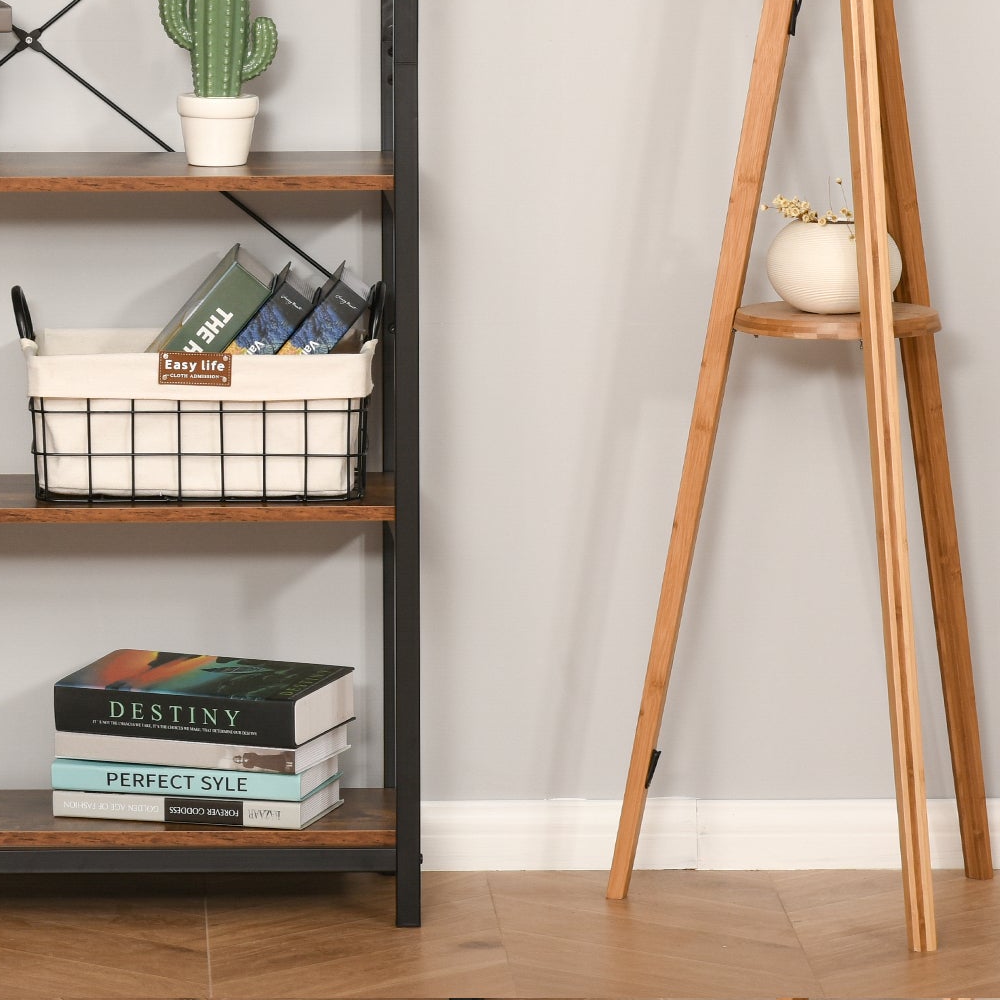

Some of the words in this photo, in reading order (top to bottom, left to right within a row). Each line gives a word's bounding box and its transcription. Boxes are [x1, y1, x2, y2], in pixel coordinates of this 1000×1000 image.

[196, 308, 234, 344] THE
[165, 360, 198, 373] Easy
[201, 360, 226, 372] life
[109, 700, 240, 726] DESTINY
[106, 772, 195, 790] PERFECT
[201, 776, 248, 792] SYLE
[169, 806, 205, 816] GODDESS
[206, 808, 239, 817] FOREVER
